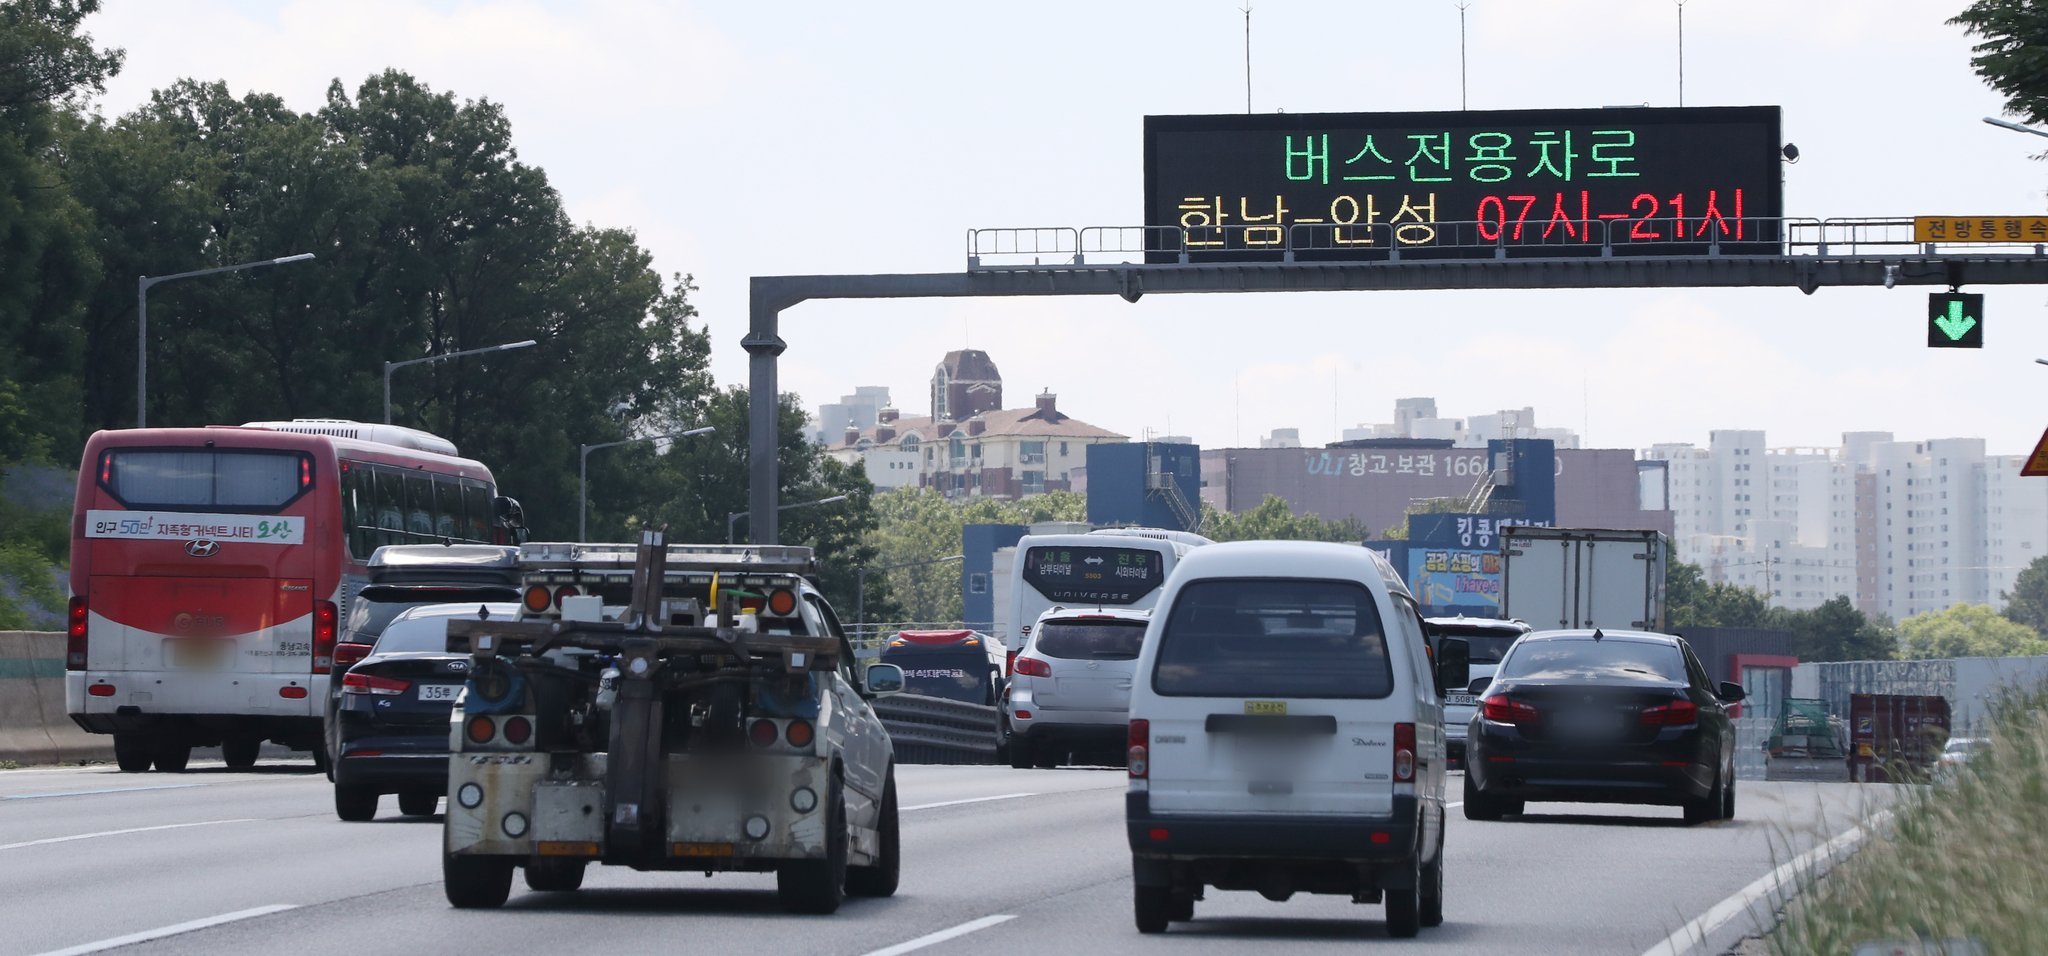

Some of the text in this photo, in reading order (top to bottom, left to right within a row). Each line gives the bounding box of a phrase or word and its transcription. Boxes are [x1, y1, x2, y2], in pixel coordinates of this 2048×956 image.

[1286, 129, 1641, 185] 버스전용차로
[1178, 188, 1743, 245] 한남-안성 07시-21시
[95, 521, 117, 534] 인구
[256, 520, 293, 539] 오산
[1042, 551, 1146, 565] 서울 진주
[1425, 551, 1448, 572] 공감
[1450, 552, 1480, 573] 쇼핑의
[1040, 564, 1147, 579] 남부터미널 시외터미널
[1463, 576, 1489, 593] have
[196, 617, 225, 628] BUS
